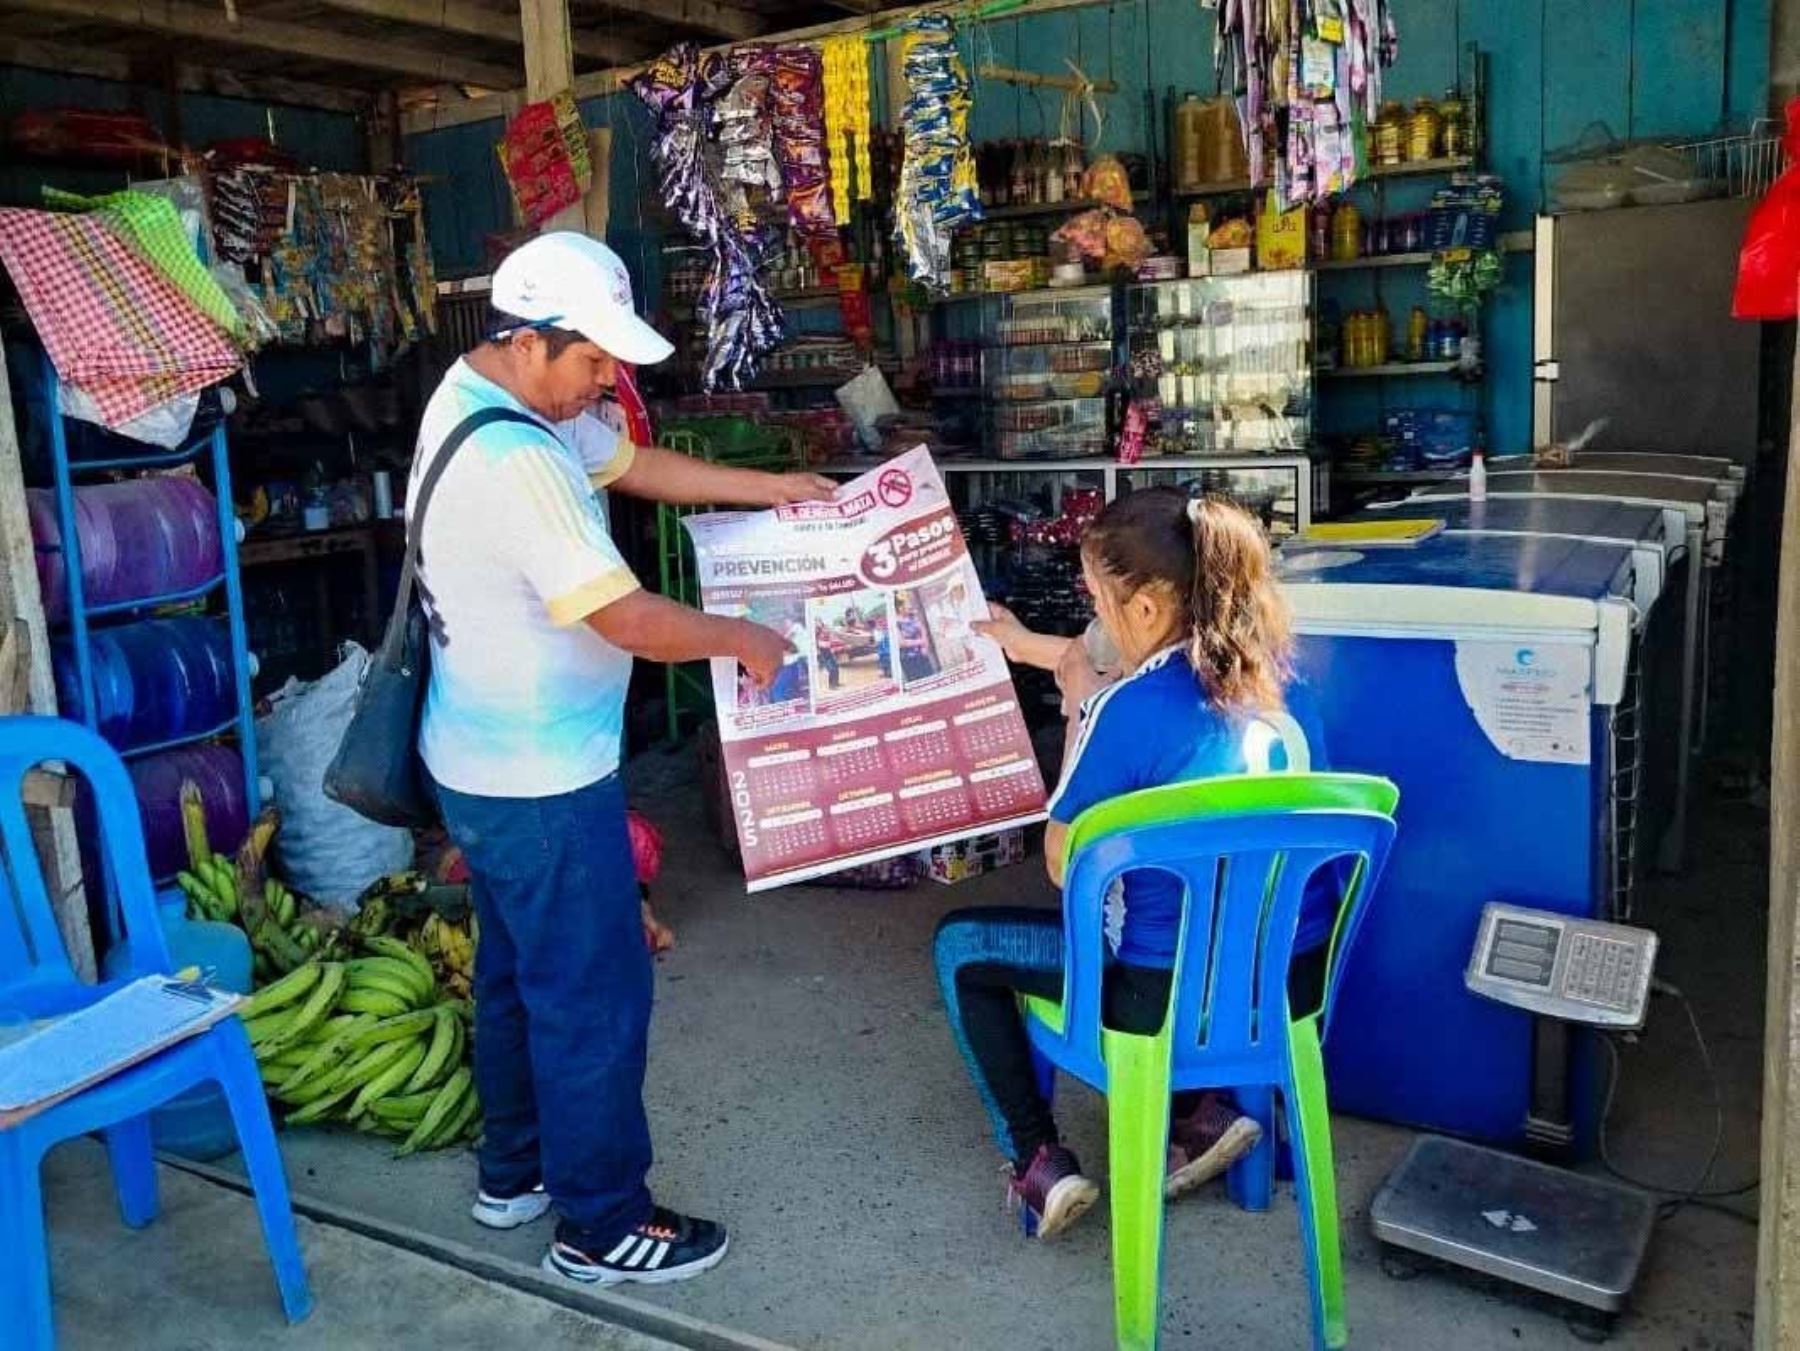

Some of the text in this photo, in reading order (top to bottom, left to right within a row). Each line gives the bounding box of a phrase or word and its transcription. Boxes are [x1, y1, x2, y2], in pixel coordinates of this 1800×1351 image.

[713, 553, 826, 577] PREVENCIÓN
[867, 540, 897, 578] 3
[891, 515, 954, 555] Pasos
[732, 770, 759, 847] 2025
